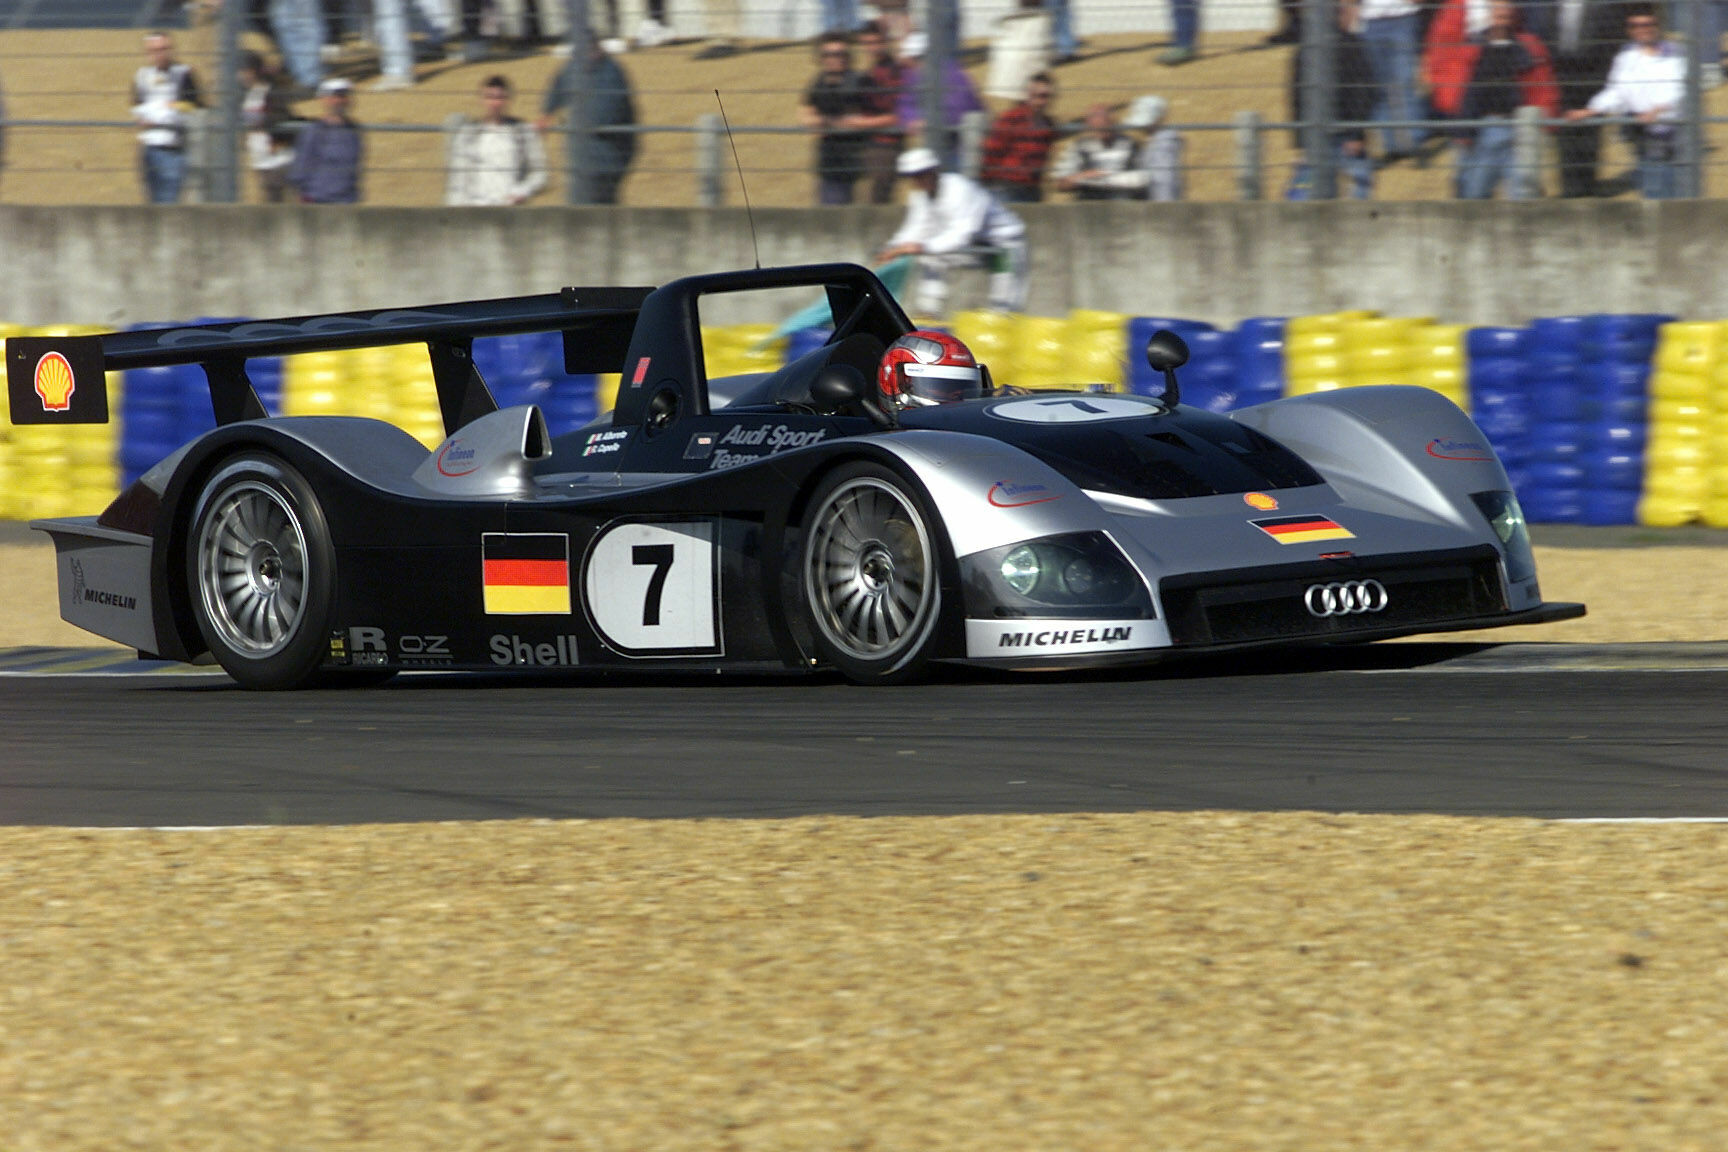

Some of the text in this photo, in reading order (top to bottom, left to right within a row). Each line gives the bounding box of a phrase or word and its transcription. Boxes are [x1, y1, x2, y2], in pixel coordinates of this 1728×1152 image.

[1035, 400, 1109, 414] 7
[719, 424, 826, 450] Audi Sport
[632, 544, 675, 627] 7
[84, 588, 137, 611] MICHELIN
[349, 626, 388, 651] R
[998, 626, 1132, 648] MICHELIN
[489, 634, 580, 666] Shell
